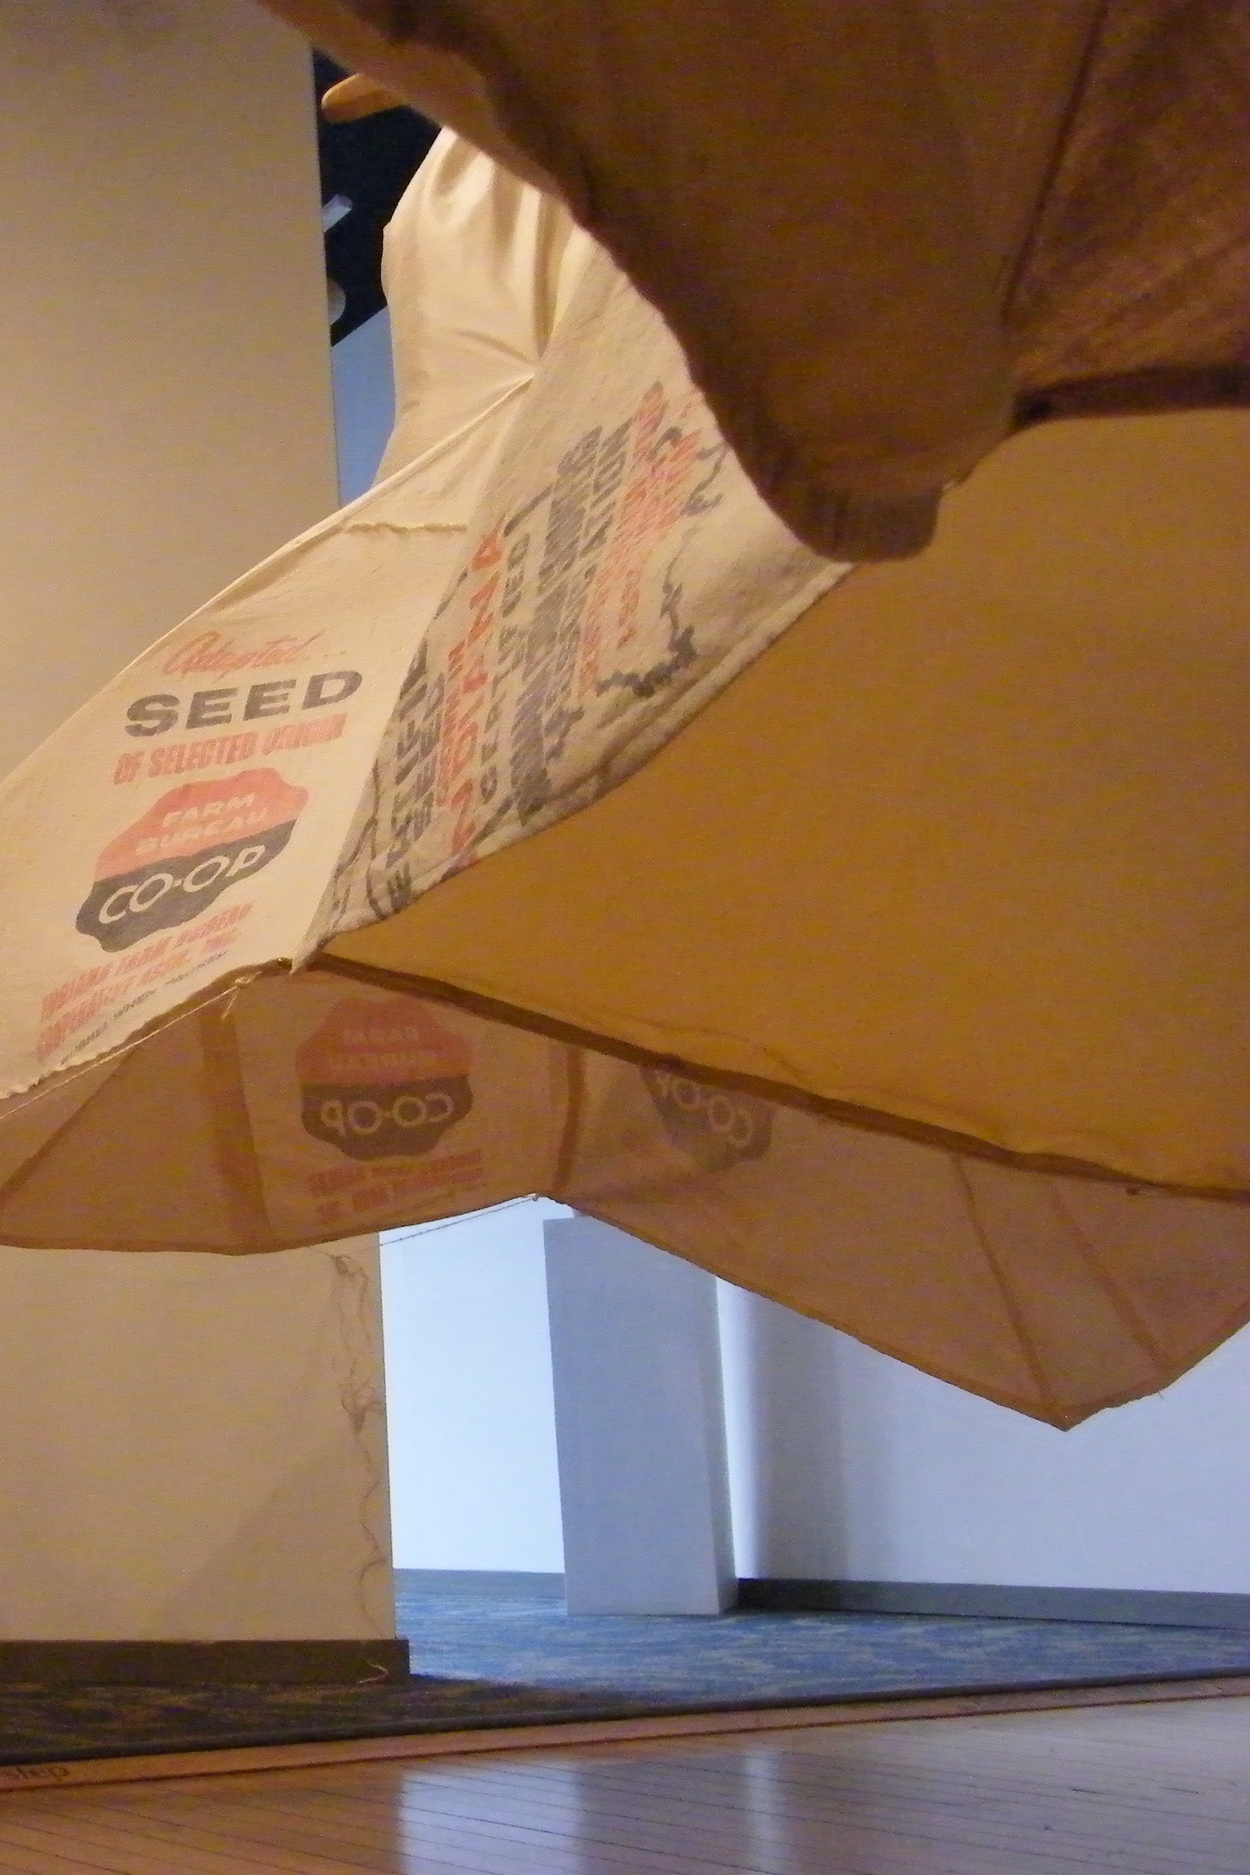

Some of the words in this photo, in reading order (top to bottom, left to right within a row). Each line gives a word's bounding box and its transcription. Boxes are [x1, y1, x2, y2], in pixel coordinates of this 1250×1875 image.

[125, 670, 362, 736] SEED
[113, 752, 145, 784] OF
[148, 731, 258, 777] SELECTED
[136, 806, 269, 854] BUREAU
[162, 793, 256, 827] FARM
[99, 844, 266, 924] CO-OP
